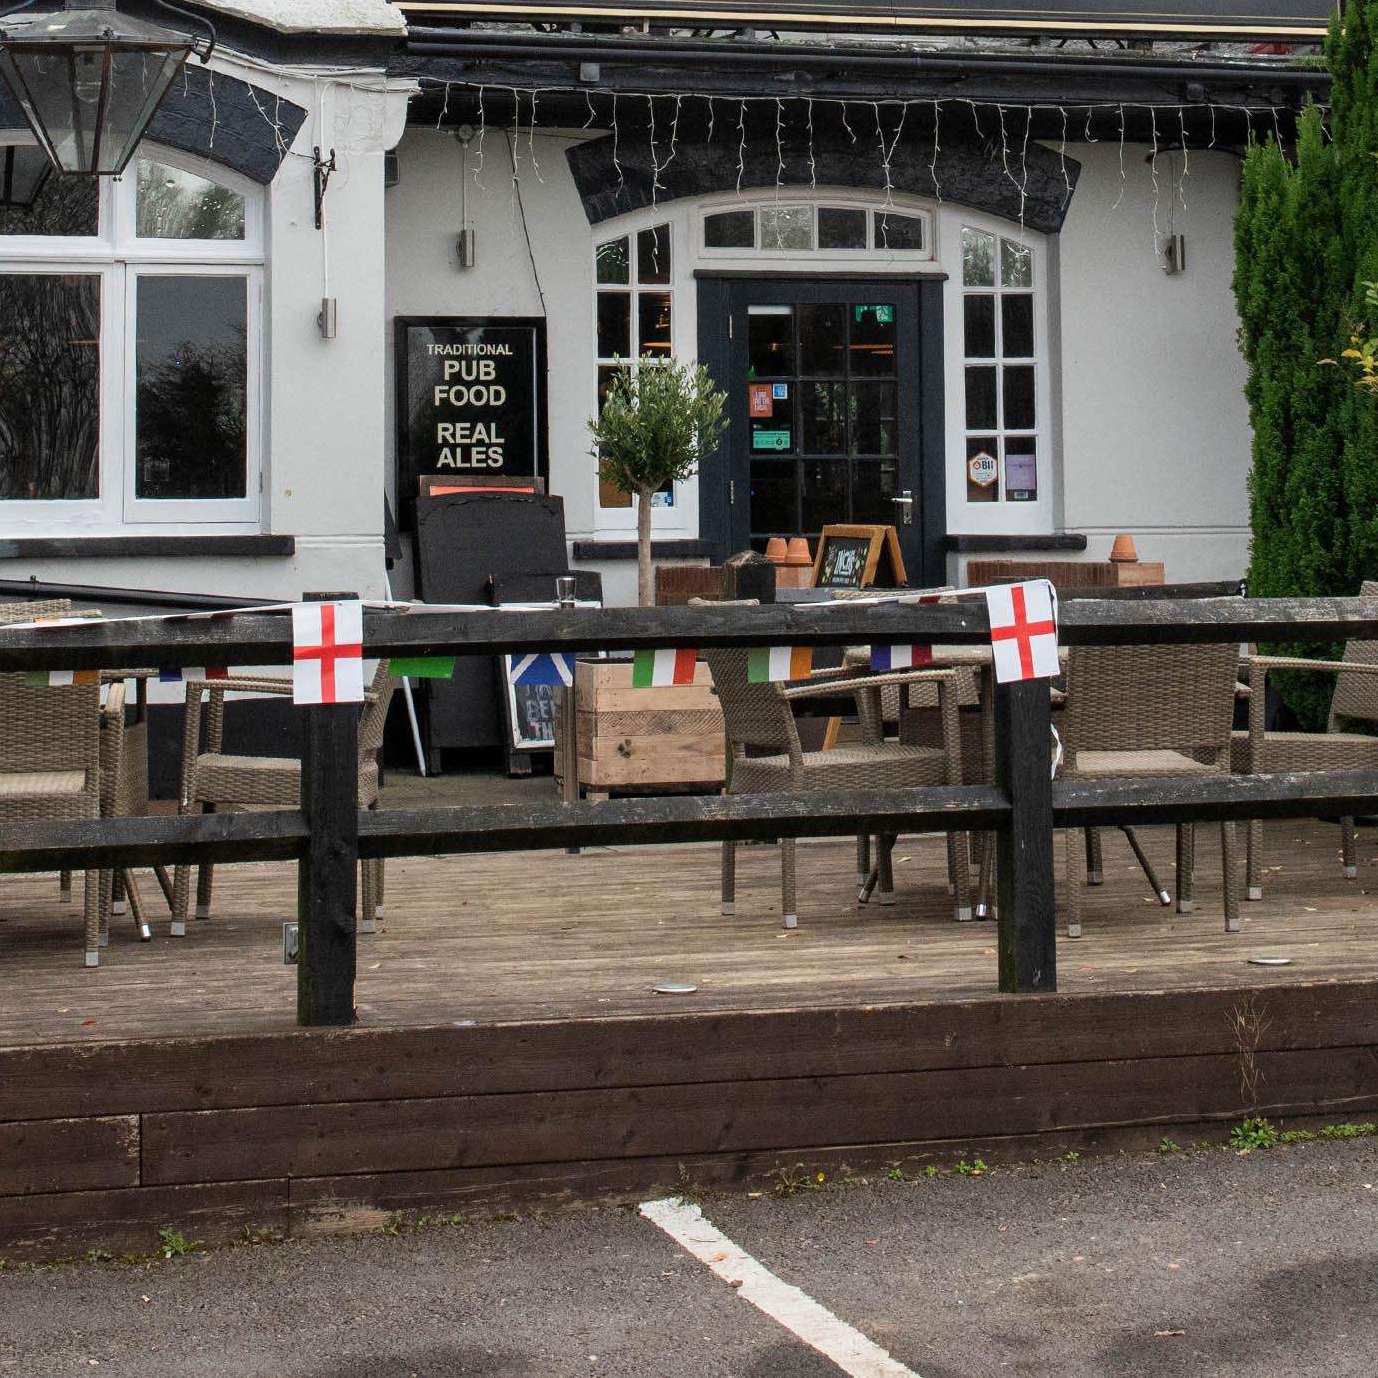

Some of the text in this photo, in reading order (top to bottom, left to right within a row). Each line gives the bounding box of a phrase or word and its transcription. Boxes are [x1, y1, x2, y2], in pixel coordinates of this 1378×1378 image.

[426, 344, 513, 355] TRADITIONAL
[444, 360, 496, 381] PUB
[434, 385, 506, 406] FOOD
[437, 422, 505, 444] REAL
[436, 447, 504, 468] ALES
